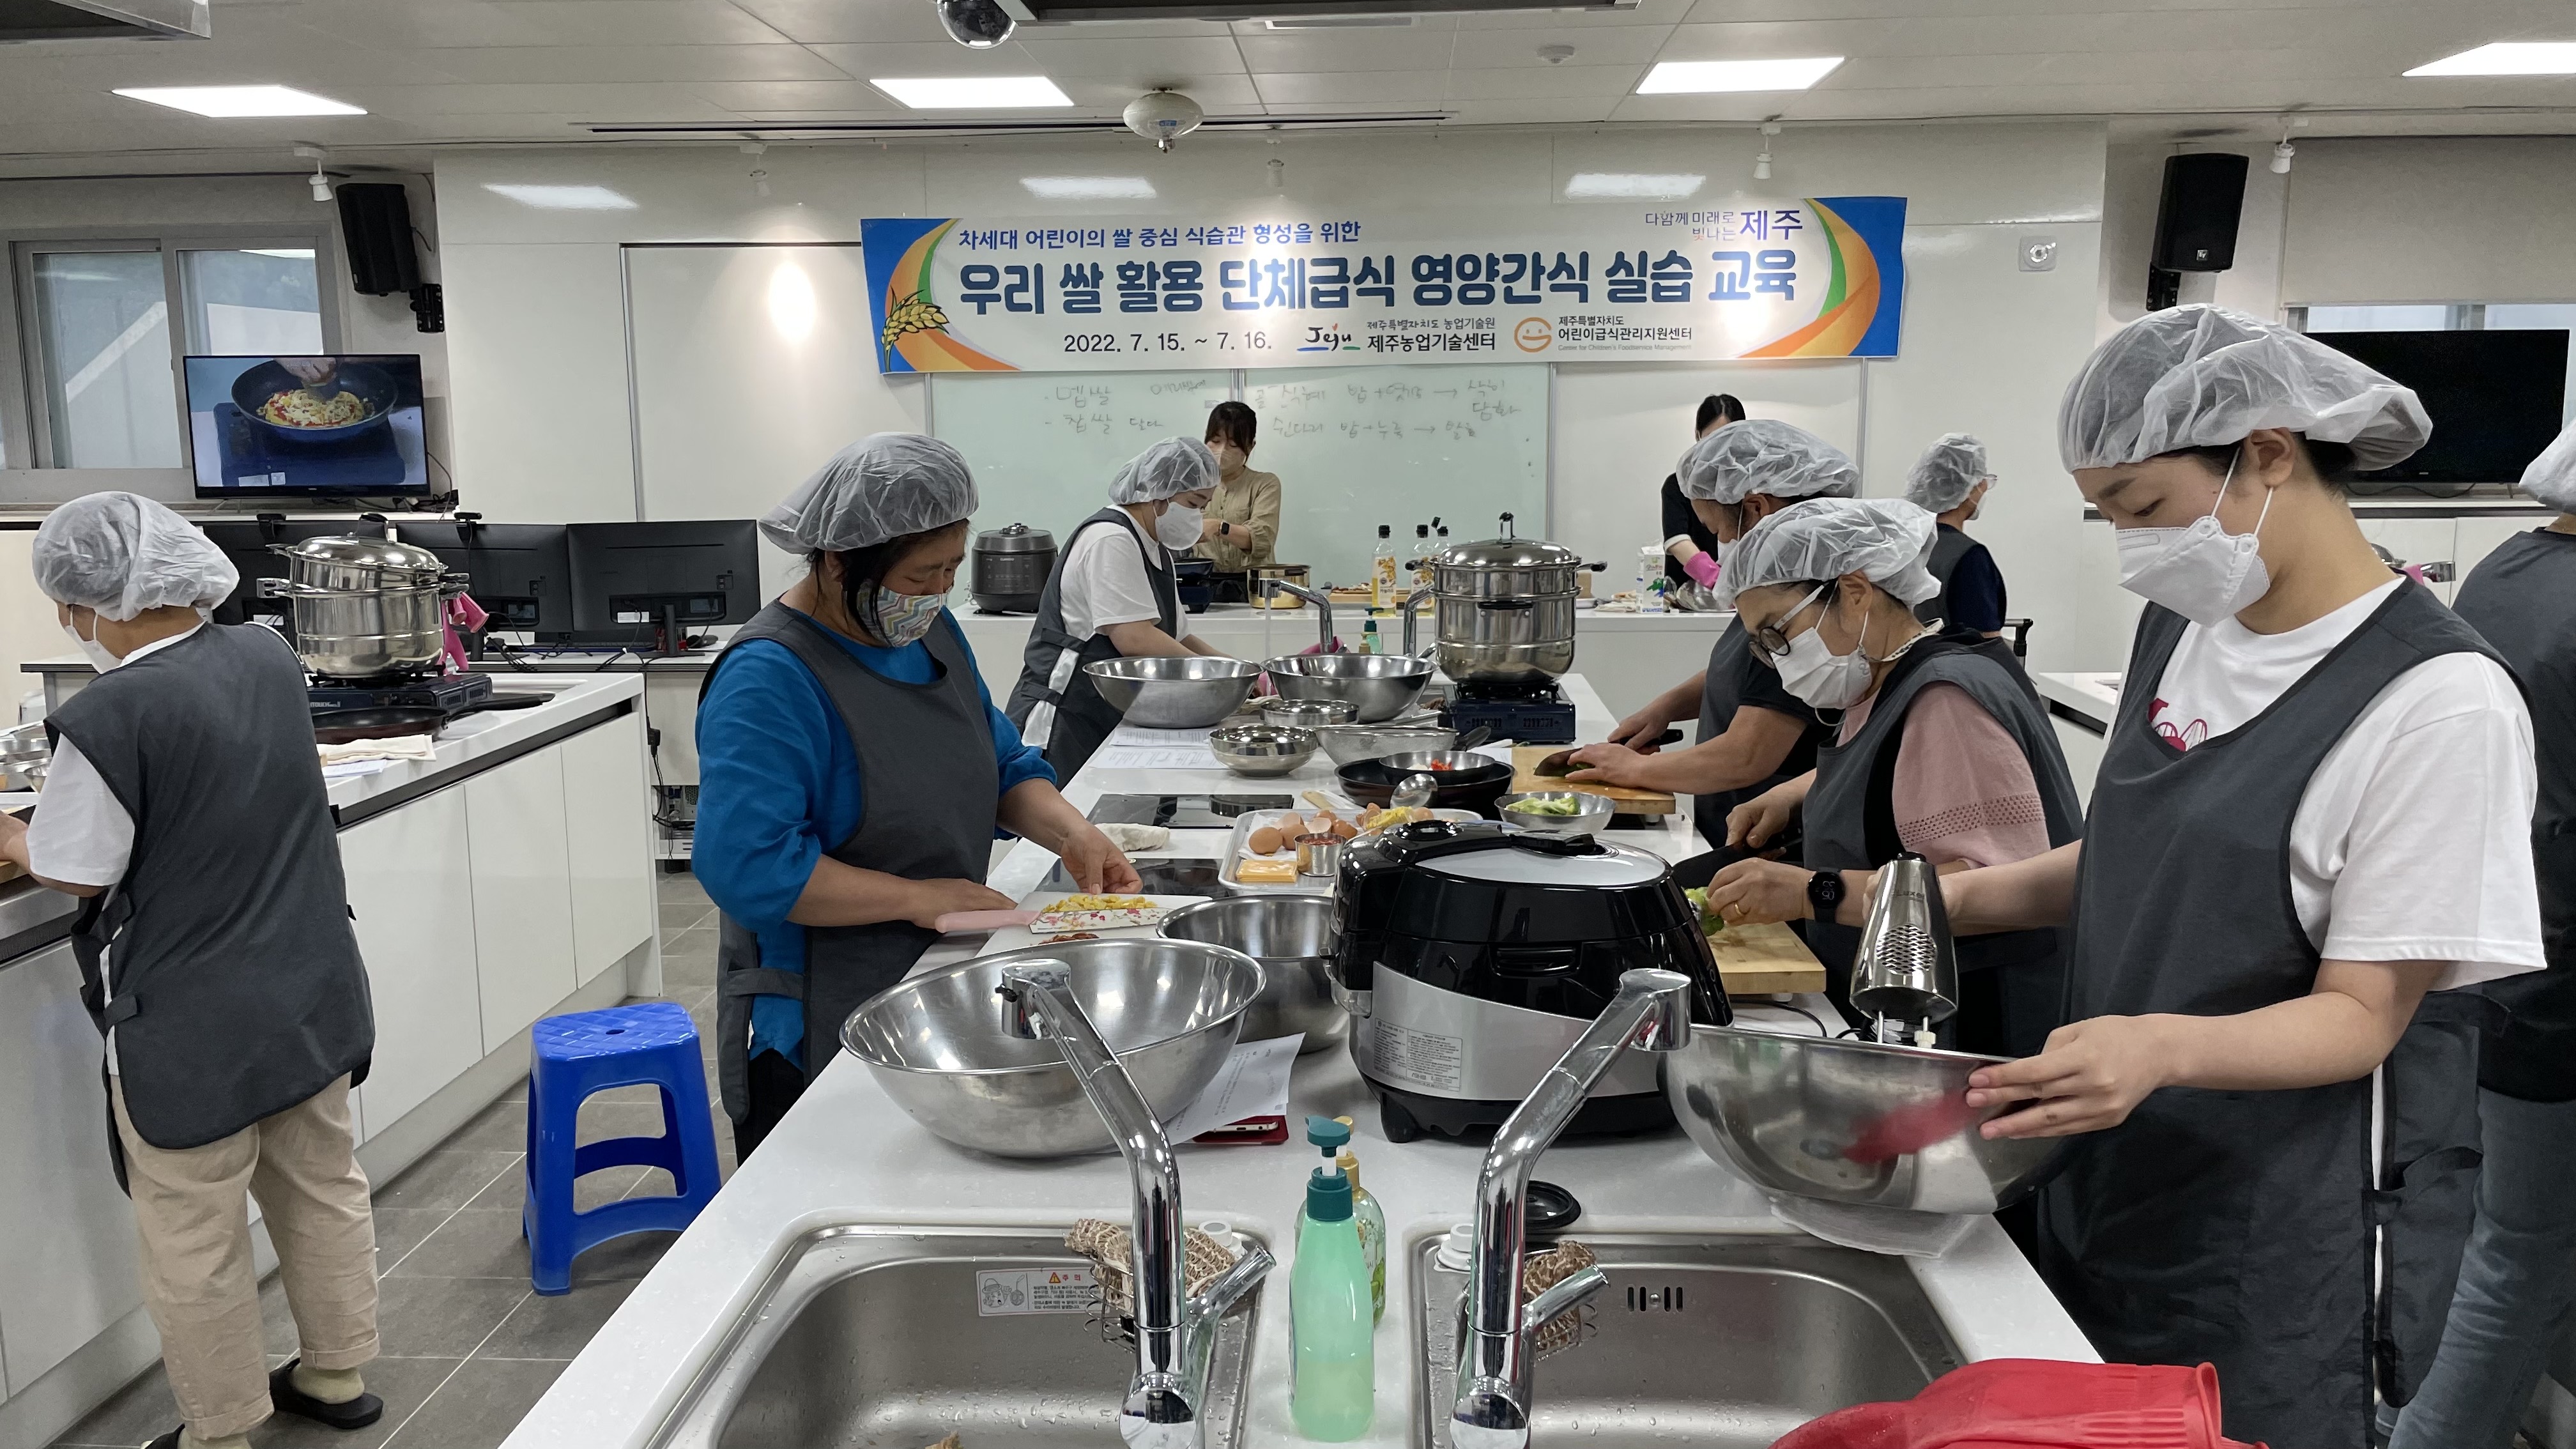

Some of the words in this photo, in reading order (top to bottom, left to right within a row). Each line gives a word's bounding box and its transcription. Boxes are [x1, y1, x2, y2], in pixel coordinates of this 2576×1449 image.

[1645, 210, 1689, 226] 다함께
[1692, 210, 1735, 225] 미래로
[1740, 210, 1803, 240] 제주
[959, 229, 1018, 250] 차세대
[1025, 229, 1105, 249] 어린이의
[1112, 228, 1133, 248] 쌀
[1138, 227, 1177, 248] 중심
[1185, 225, 1246, 246] 식습관
[1254, 222, 1314, 245] 형성을
[1320, 220, 1361, 243] 위한
[1692, 226, 1736, 241] 빛나는
[960, 263, 1046, 316] 우리
[1059, 261, 1105, 314] 쌀
[1116, 260, 1204, 313] 활용
[1219, 255, 1395, 310] 단체급식
[1411, 250, 1589, 307] 영양간식
[1604, 250, 1694, 303] 실습
[1708, 249, 1797, 302] 교육
[1367, 319, 1439, 331] 제주특별자치도
[1443, 317, 1496, 330] 농업기술원
[1558, 316, 1625, 326] 제주특별자치도
[1064, 334, 1121, 353] 2022.
[1130, 334, 1149, 352] 7.
[1157, 332, 1185, 351] 15.
[1216, 332, 1235, 350] 7.
[1244, 331, 1272, 349] 16.
[1305, 326, 1351, 351] Jeju
[1367, 332, 1496, 353] 제주농업기술센터
[1558, 327, 1692, 341] 어린이급식관리지원센터
